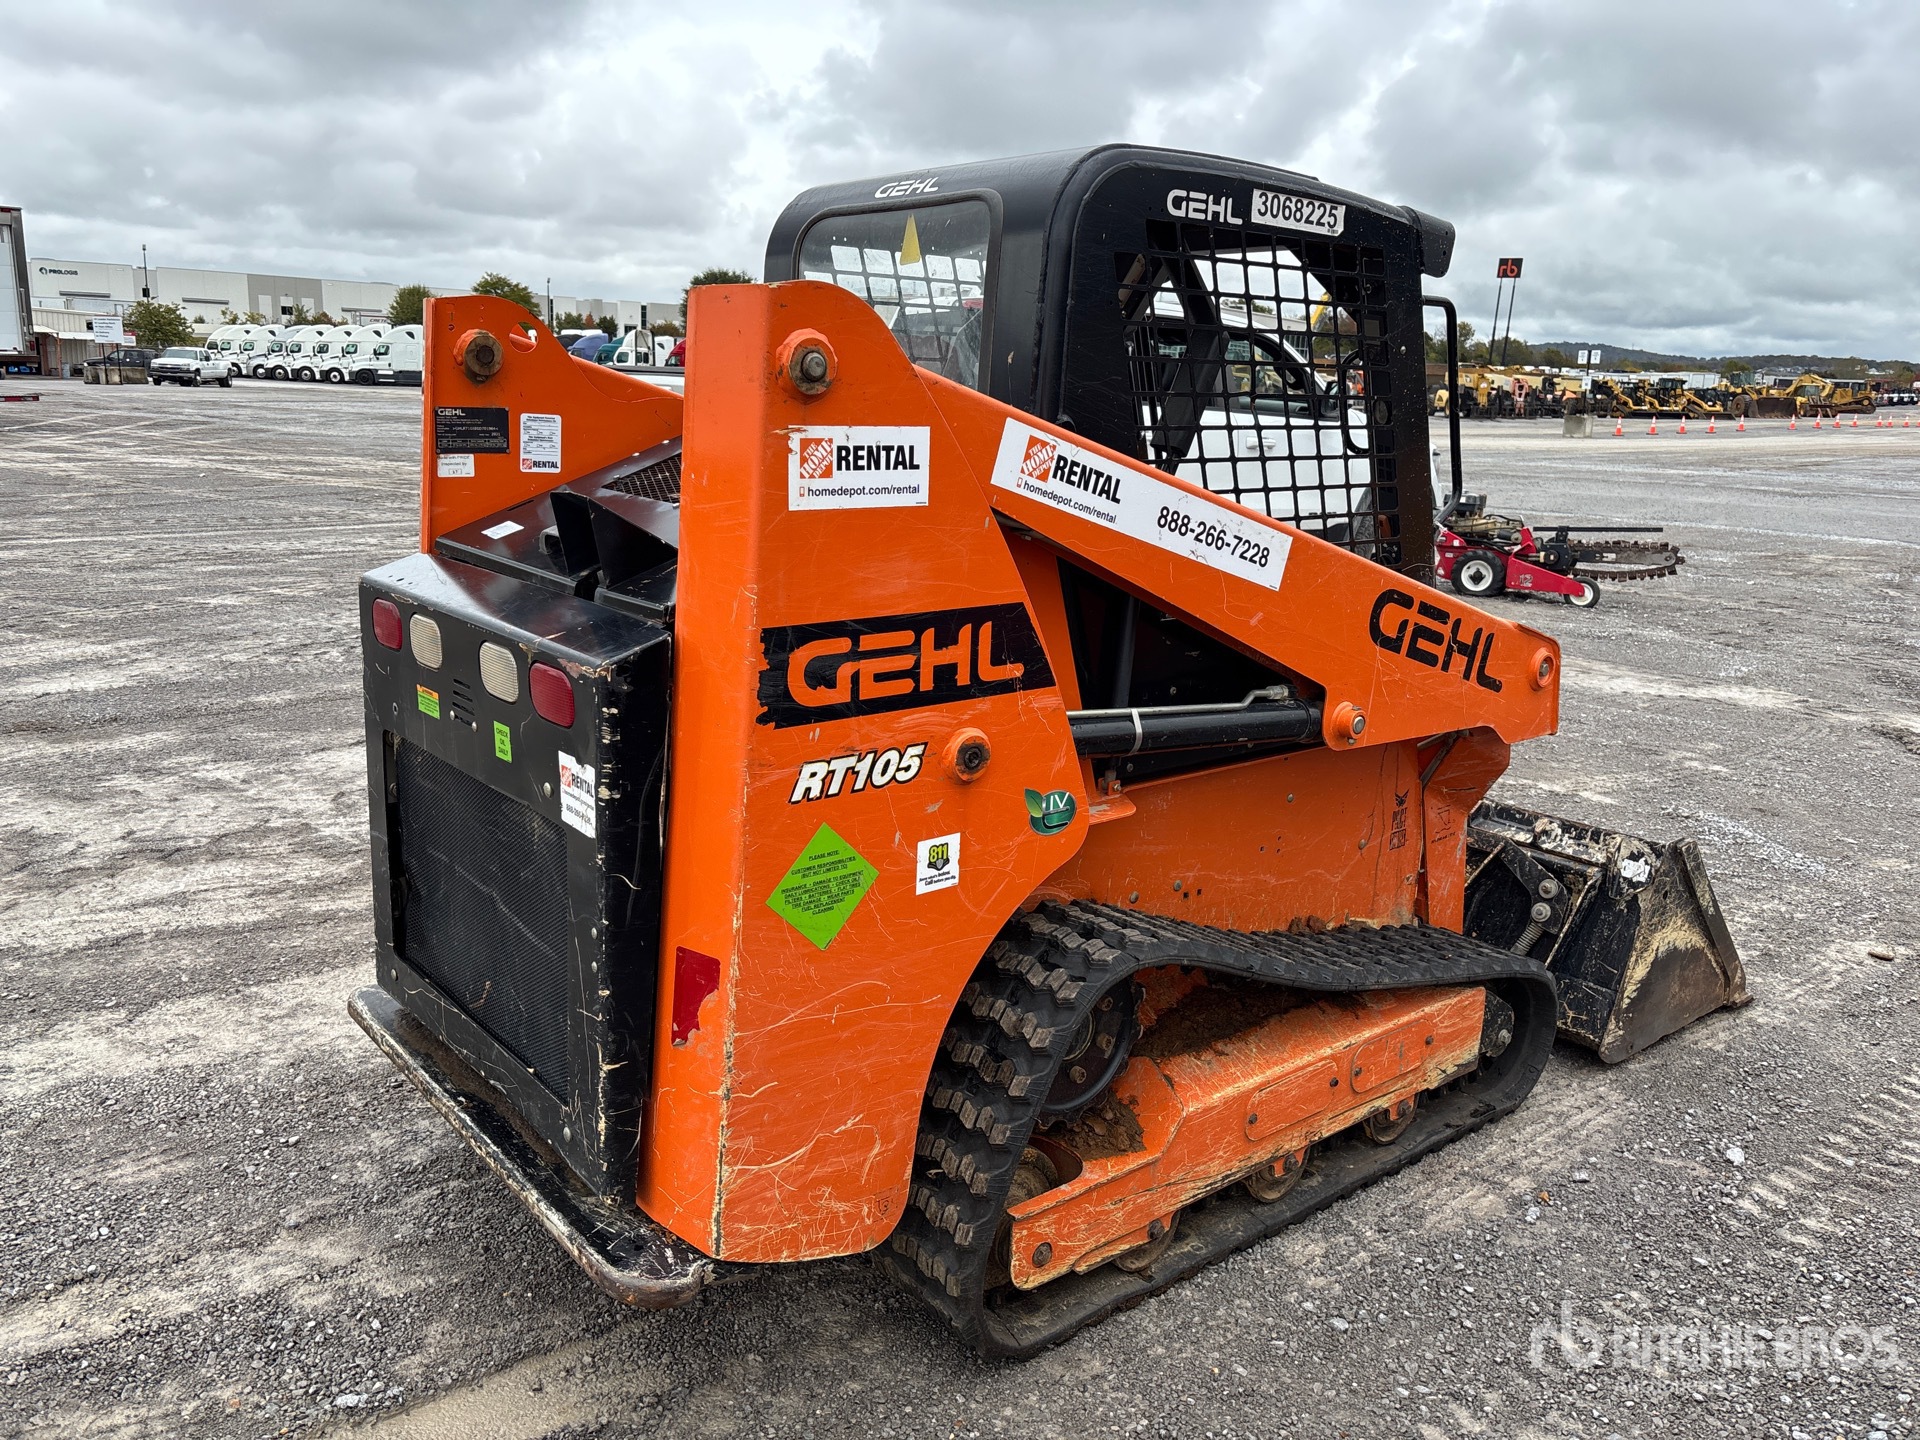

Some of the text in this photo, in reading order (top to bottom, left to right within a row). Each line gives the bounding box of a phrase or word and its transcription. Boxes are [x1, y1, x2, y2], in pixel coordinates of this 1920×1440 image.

[875, 177, 938, 198] GEHL
[1167, 189, 1243, 225] GEHL
[1257, 192, 1338, 229] 3068225
[800, 438, 833, 479] HOME
[803, 442, 818, 458] THE
[836, 445, 920, 471] RENTAL
[533, 461, 559, 469] RENTAL
[813, 453, 833, 479] DEPOT
[808, 484, 920, 498] homedepot.com/rental
[1052, 454, 1121, 504] RENTAL
[1023, 479, 1117, 524] homedepot.com/rental
[1157, 506, 1270, 568] 888-266-7228
[1368, 588, 1503, 693] GEHL
[788, 621, 1024, 708] GEHL
[572, 772, 594, 798] RENTAL
[789, 742, 928, 804] RT105
[929, 842, 948, 863] 811
[781, 884, 807, 894] INSURANCE
[839, 870, 864, 880] EQUIPMENT
[791, 865, 815, 875] CUSTOMER
[823, 866, 839, 874] LIMITED
[803, 898, 822, 906] DAMAGE
